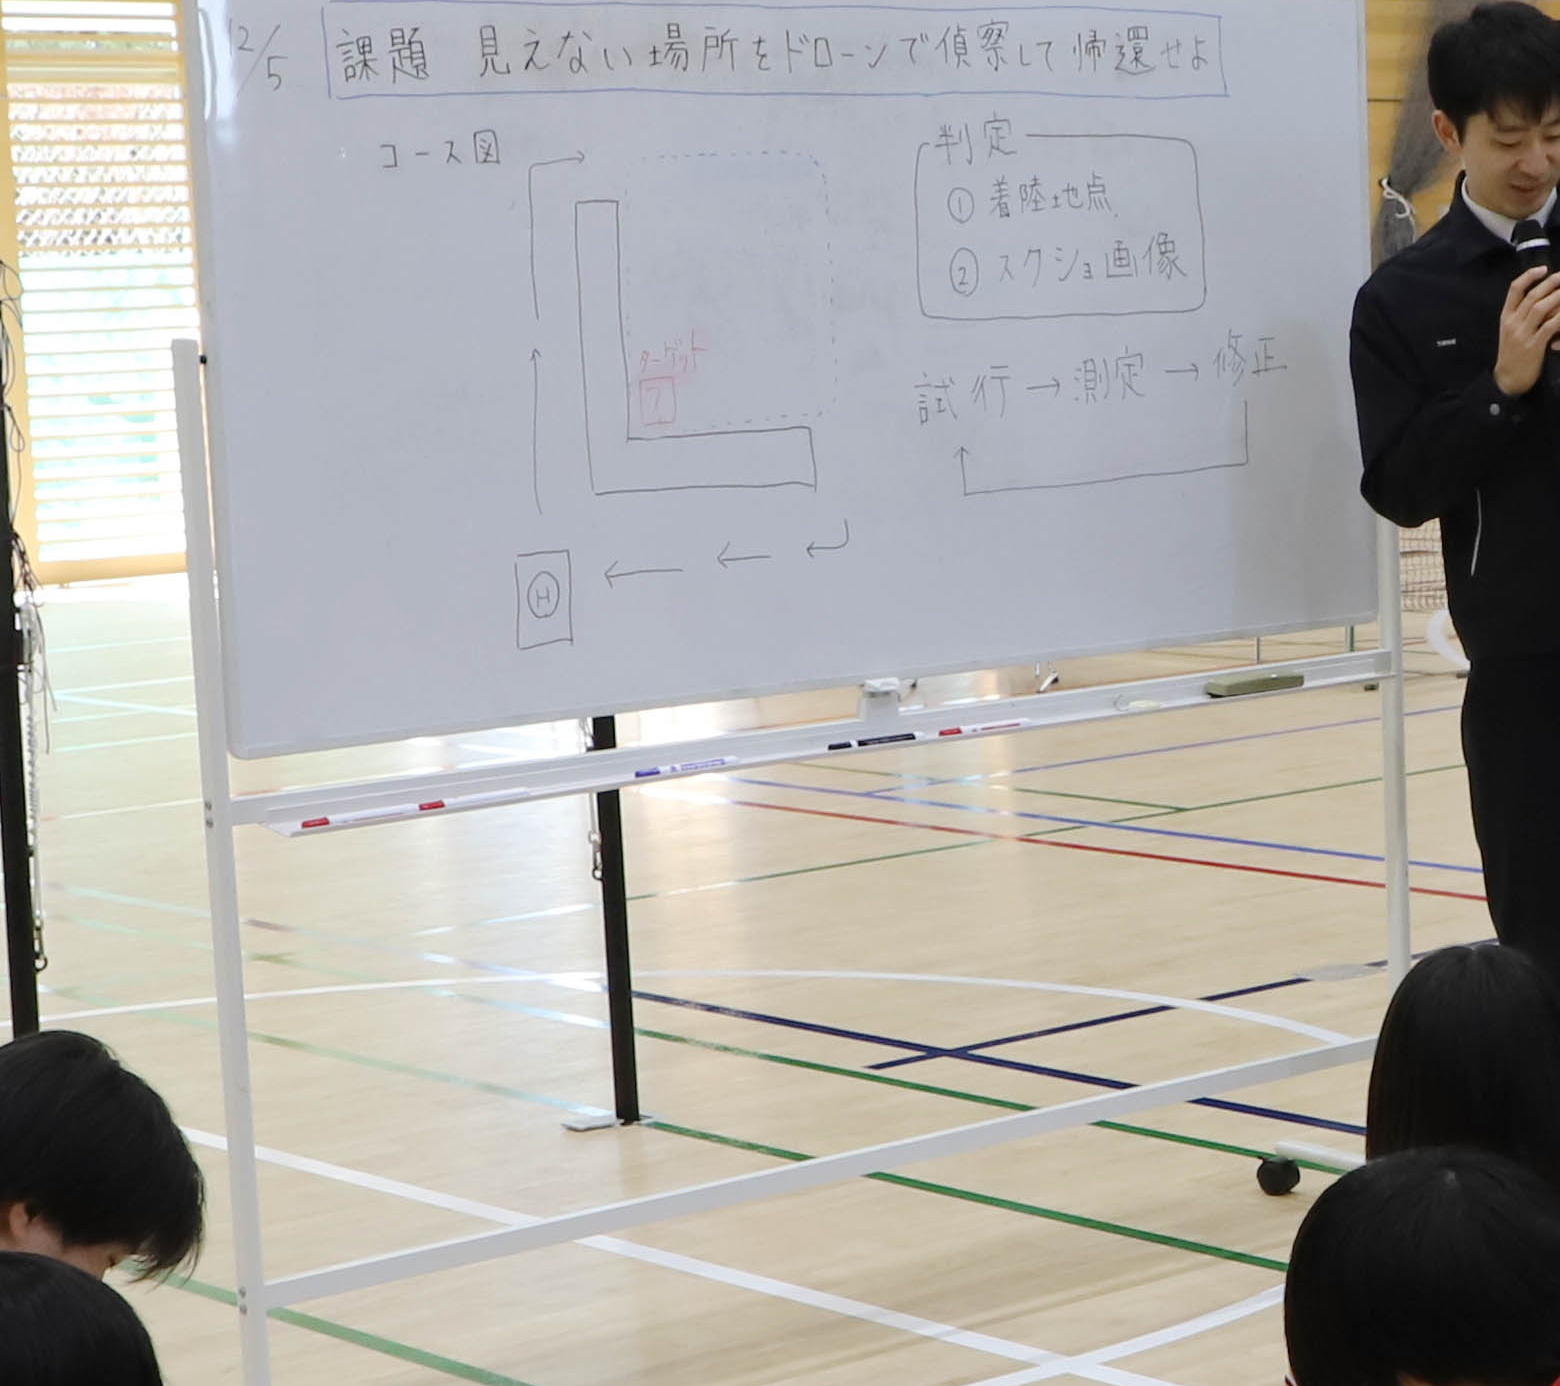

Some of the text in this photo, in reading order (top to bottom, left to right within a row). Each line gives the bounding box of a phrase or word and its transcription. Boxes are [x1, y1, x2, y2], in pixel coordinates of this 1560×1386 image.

[336, 25, 430, 84] 課題
[379, 129, 501, 169] コース図
[933, 112, 1018, 165] 判定
[997, 231, 1188, 288] スクショ画像
[914, 328, 1289, 426] 試行 測定 修正
[535, 586, 551, 609] H
